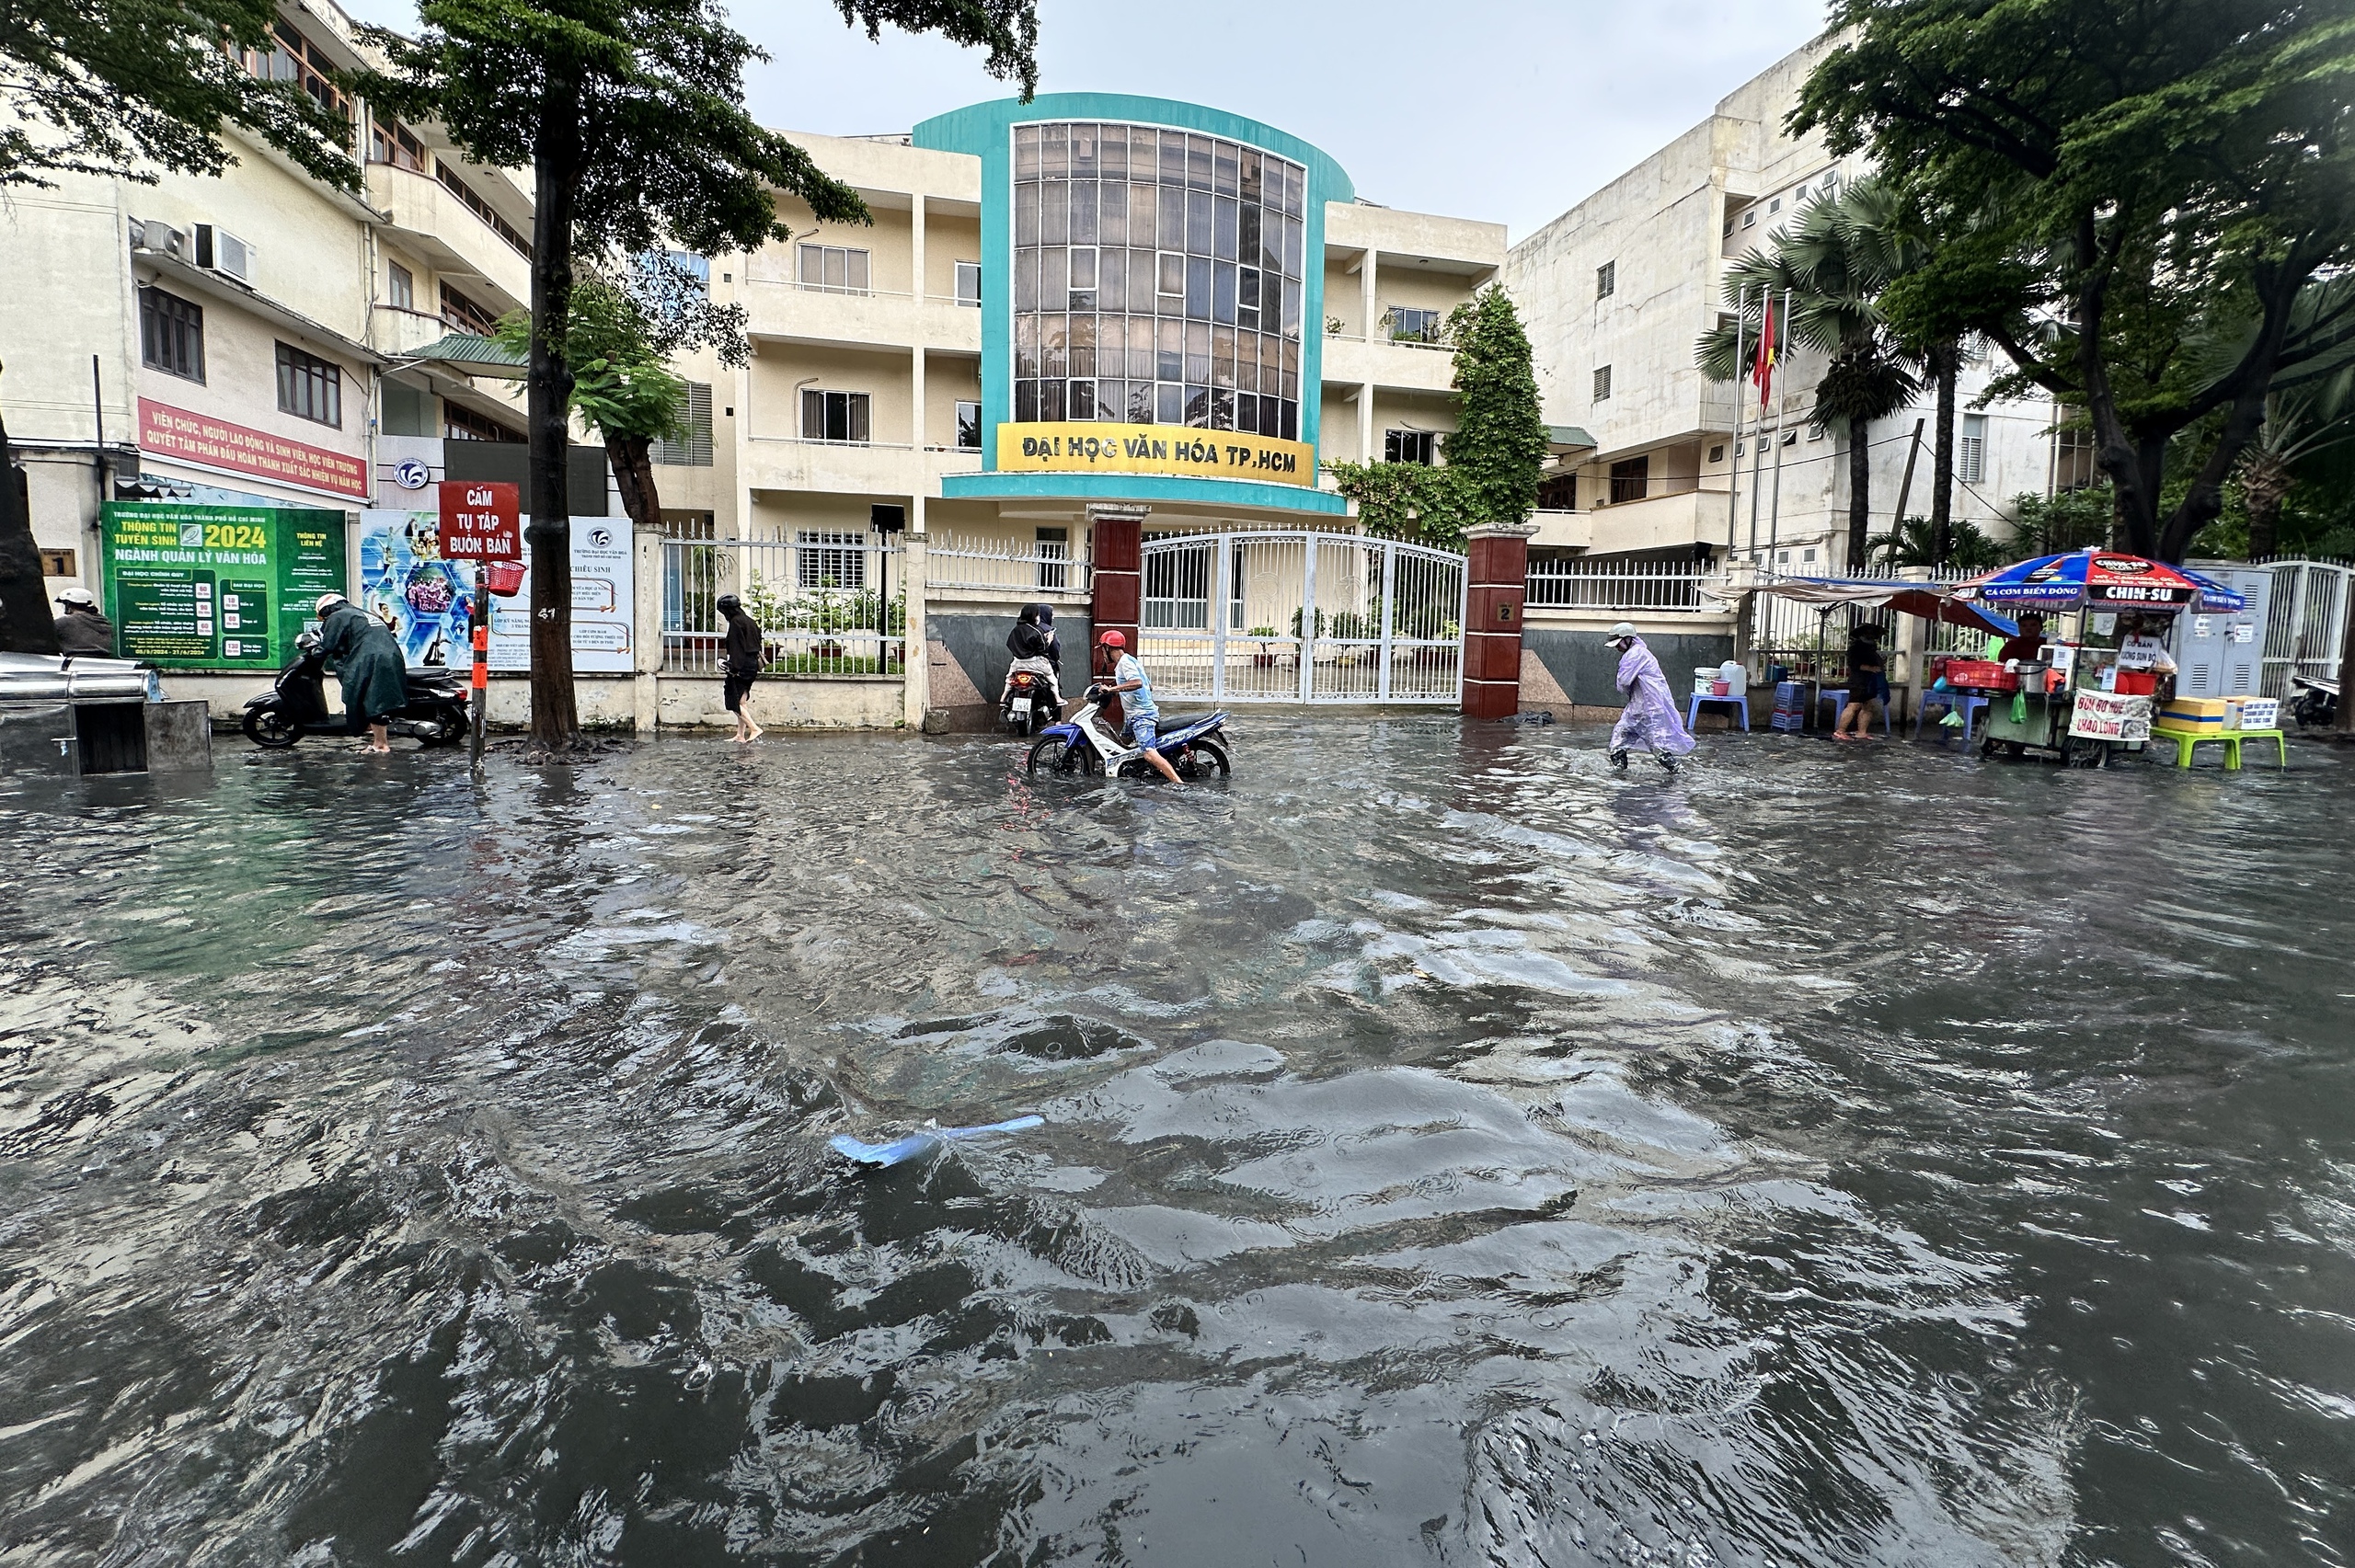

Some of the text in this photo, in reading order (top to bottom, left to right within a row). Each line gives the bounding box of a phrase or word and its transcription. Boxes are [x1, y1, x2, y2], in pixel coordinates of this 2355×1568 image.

[152, 411, 173, 429] VIÊN
[175, 418, 201, 438] CHỨC,
[202, 426, 228, 441] NGƯỜI
[230, 432, 243, 445] LAO
[246, 435, 264, 452] ĐỘNG
[266, 440, 275, 453] VÀ
[276, 444, 291, 458] SINH
[309, 453, 321, 467] HỌC
[322, 456, 335, 469] VIÊN
[336, 461, 358, 475] TRƯỜNG
[147, 429, 362, 491] QUYẾT TÂM PHẤN ĐẤU HOÀN THÀNH XUẤT SẮC NHIỆM VỤ NĂM HỌC
[1023, 433, 1295, 473] ĐẠI HỌC VĂN HÓA TP.HCM
[467, 486, 492, 506] CẤM
[121, 521, 177, 532] THÔNG TIN
[456, 511, 500, 532] TỤ TẬP
[114, 532, 177, 545] TUYỂN SINH
[205, 524, 267, 548] 2024
[450, 533, 482, 553] BUÔN
[487, 534, 511, 554] BÁN
[115, 548, 267, 565] NGÀNH QUẢN LÝ VĂN HÓA
[52, 557, 64, 574] 1
[1985, 588, 1998, 596] CÁ
[2023, 587, 2046, 595] BIỂN
[2107, 587, 2172, 601] CHIN-SU
[1501, 609, 1510, 620] 2
[2138, 640, 2153, 648] BÁN
